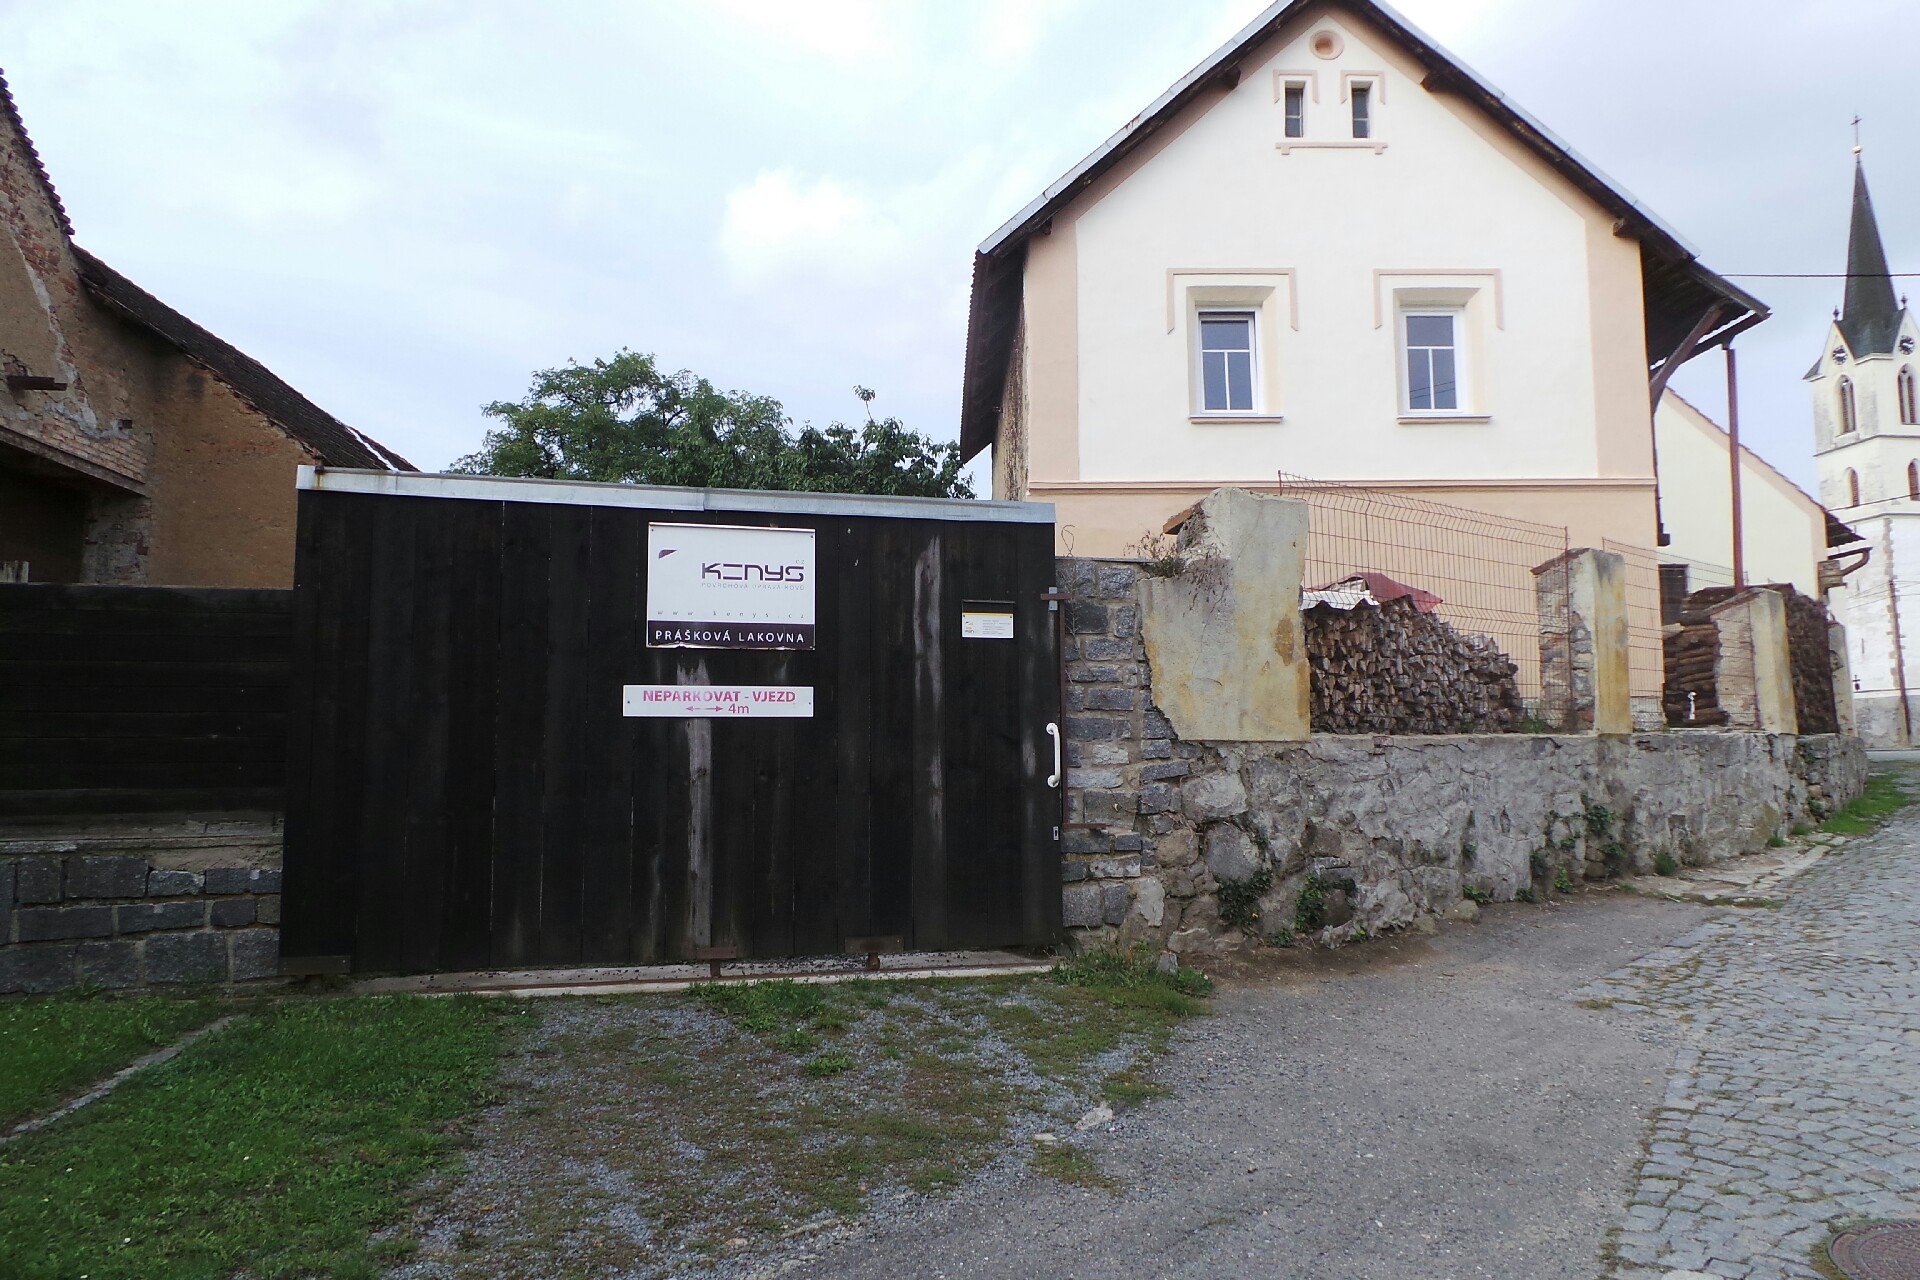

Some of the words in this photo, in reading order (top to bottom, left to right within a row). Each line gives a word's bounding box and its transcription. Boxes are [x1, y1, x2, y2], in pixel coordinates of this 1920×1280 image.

[655, 629, 731, 642] PRÁŠKOVÁ
[738, 632, 804, 643] LAKOVNA
[643, 690, 741, 702] NEPARKOVAT
[752, 691, 796, 702] VJEZD
[728, 703, 750, 714] 4m
